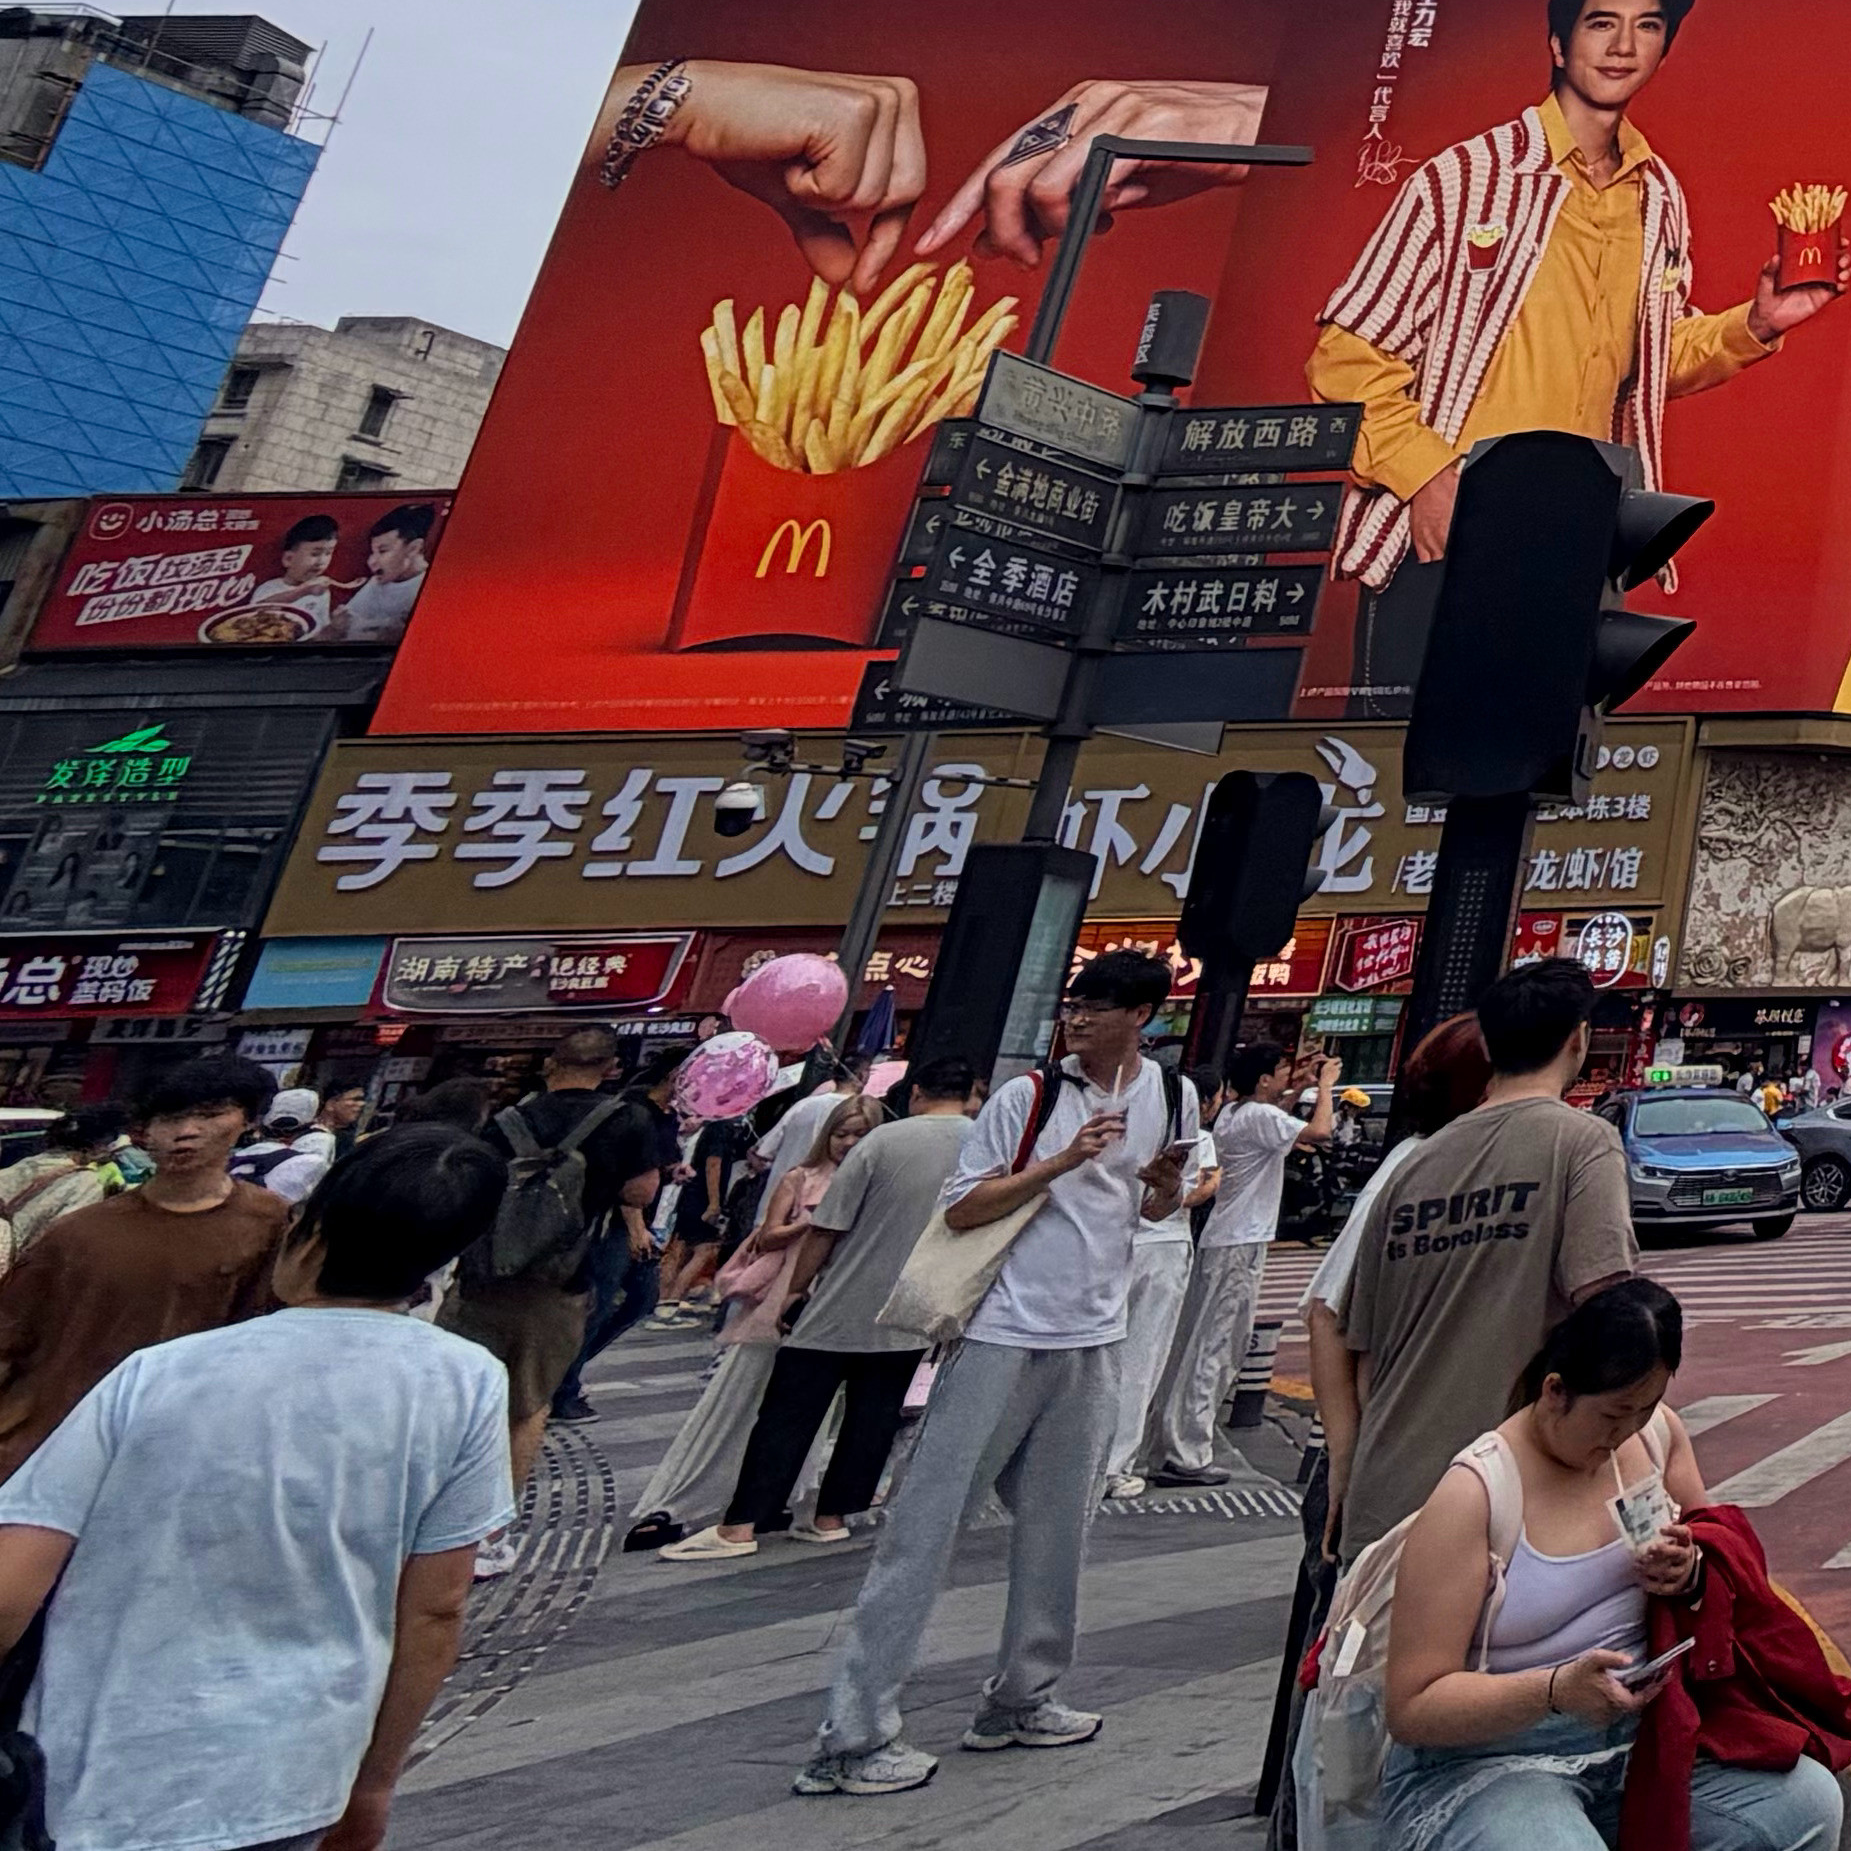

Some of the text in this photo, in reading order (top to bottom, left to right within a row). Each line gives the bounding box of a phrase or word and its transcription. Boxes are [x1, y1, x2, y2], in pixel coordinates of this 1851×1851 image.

[1180, 415, 1348, 452] 解放西路 西
[135, 509, 220, 534] 小汤总
[1162, 498, 1298, 534] 吃饭皇帝大
[968, 548, 1080, 609] 全季酒店
[1141, 578, 1279, 616] 木村武日料
[315, 763, 986, 892] 季季红火锅
[0, 955, 69, 1005] 总
[81, 955, 139, 979] 现炒
[394, 953, 530, 982] 湖南特产
[1390, 1181, 1541, 1236] SPIRIT
